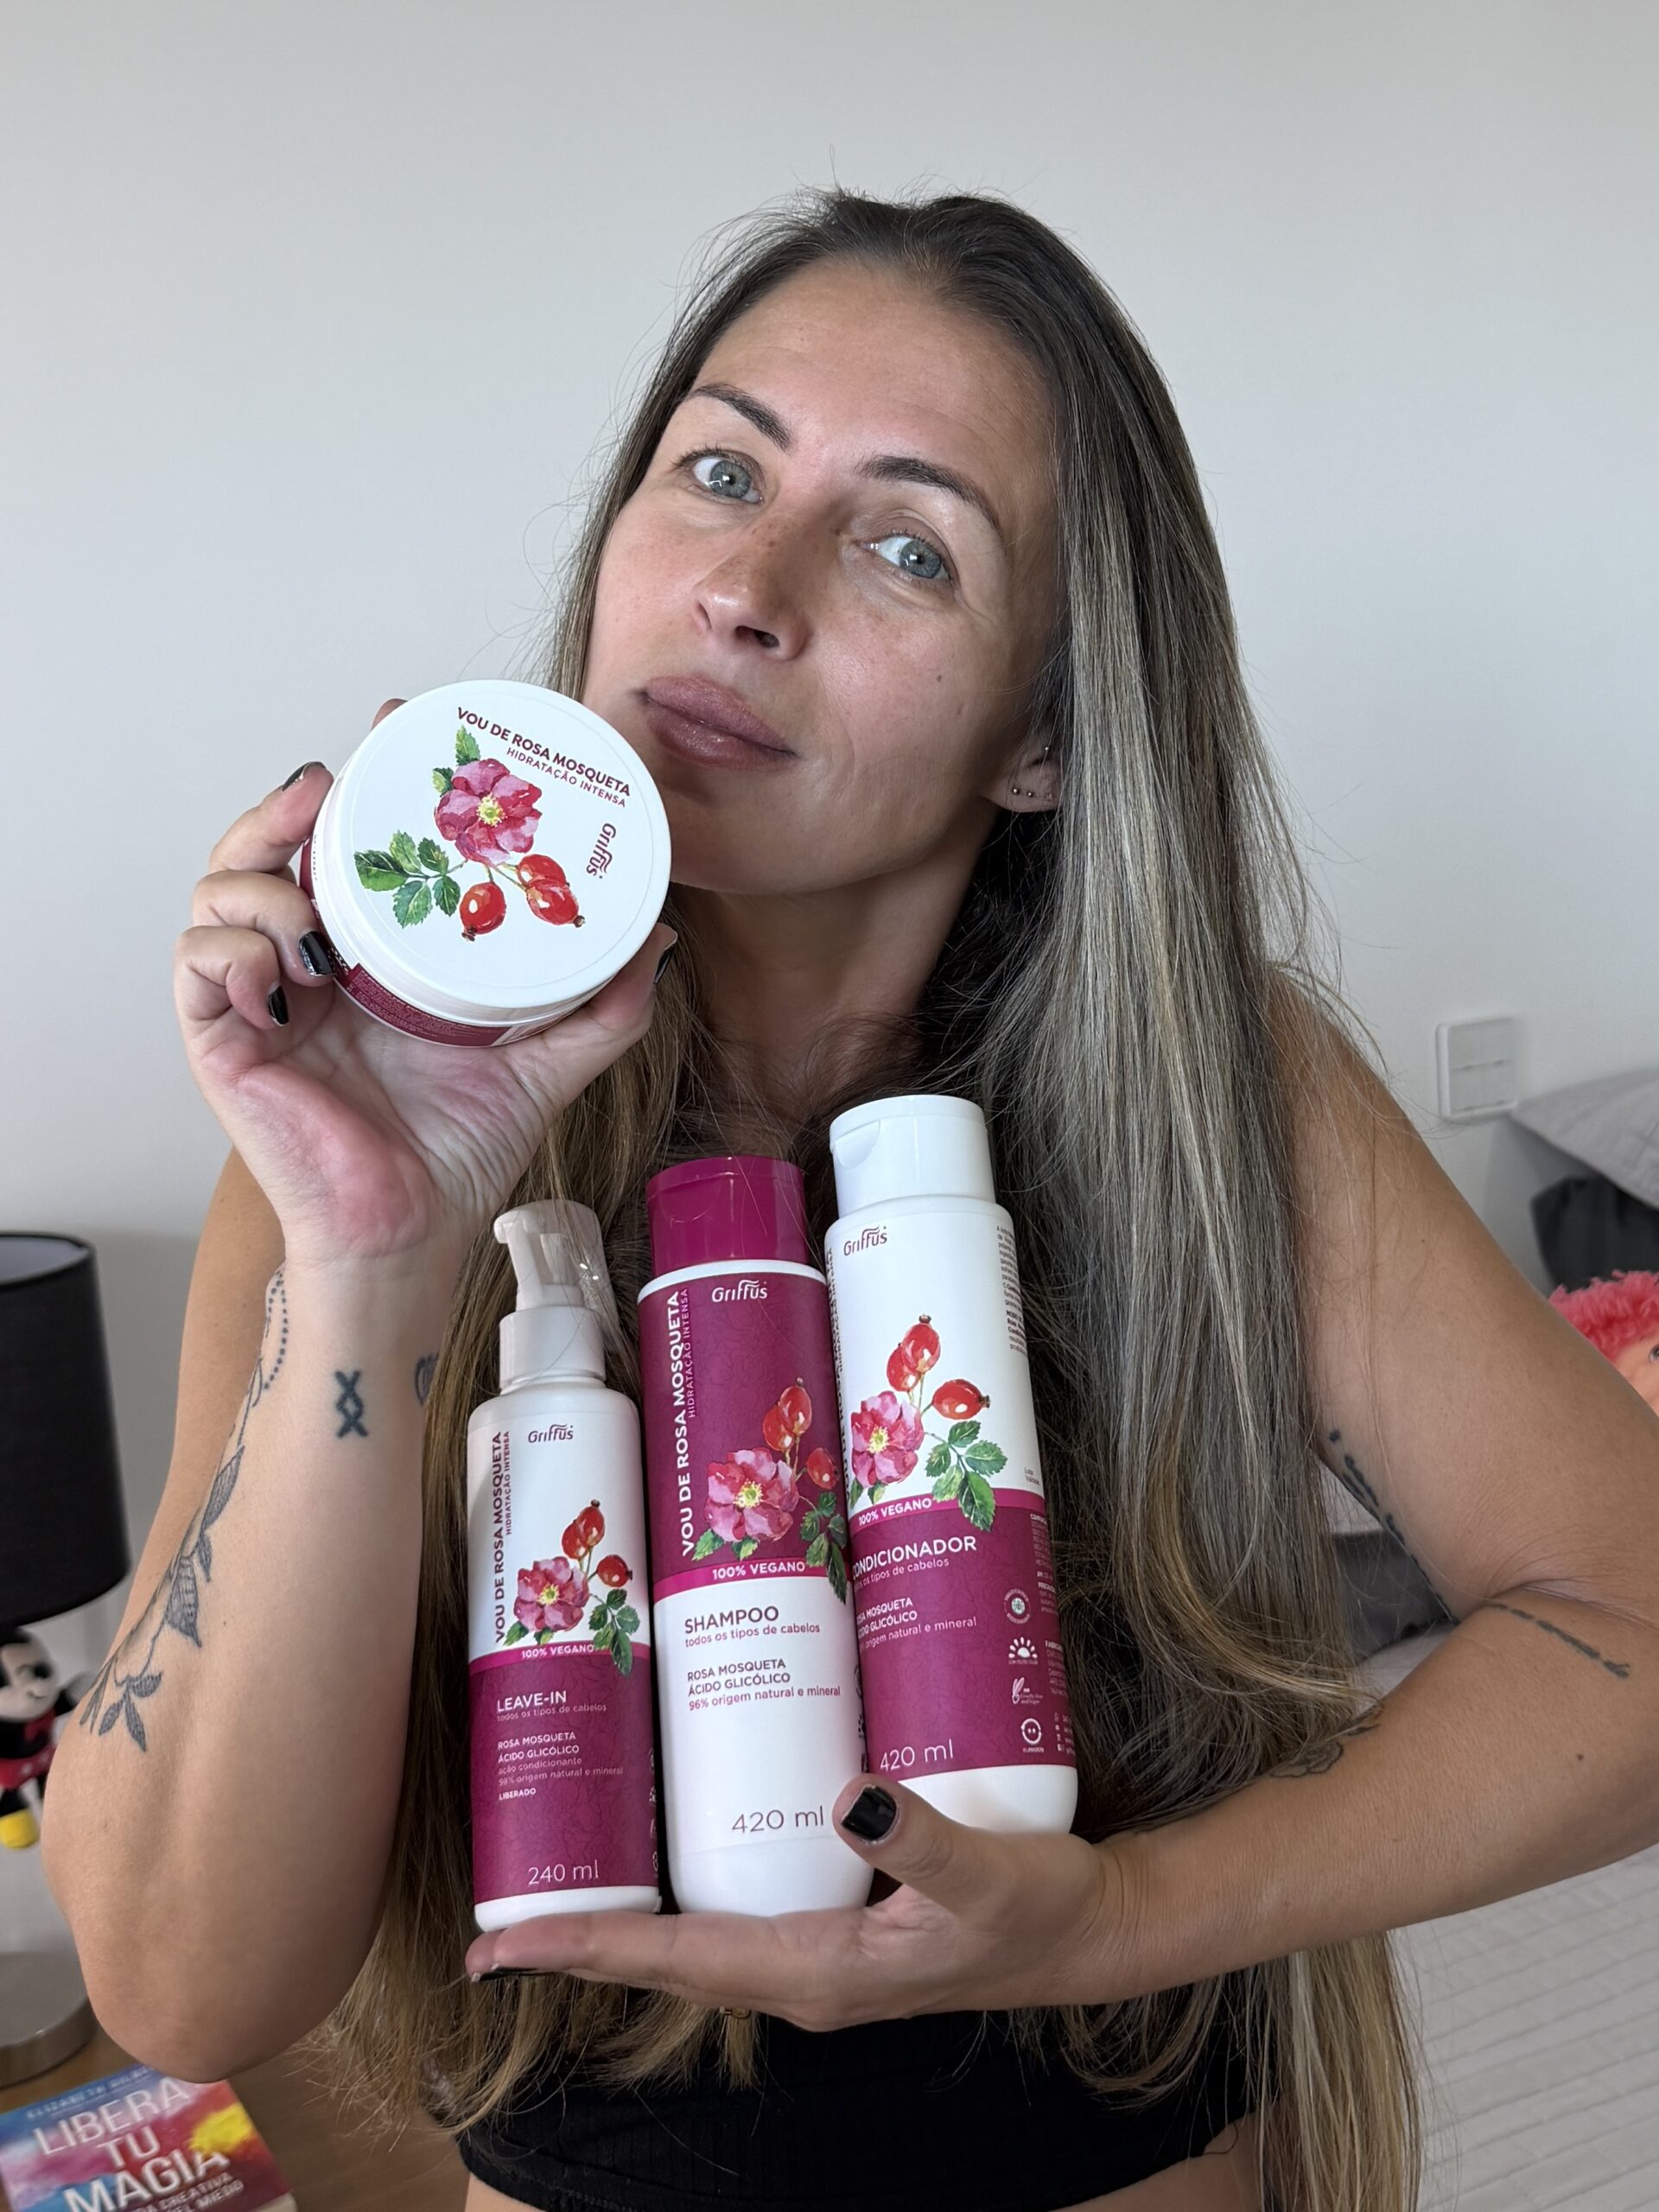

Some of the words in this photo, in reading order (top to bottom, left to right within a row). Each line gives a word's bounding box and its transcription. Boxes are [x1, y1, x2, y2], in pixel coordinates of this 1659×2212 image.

[458, 707, 489, 730] VOU
[490, 723, 512, 741] DE
[512, 734, 550, 760] ROSA
[553, 753, 631, 797] MOSQUETA
[506, 747, 576, 785] HIDRATAÇÃO
[580, 781, 626, 808] INTENSA
[586, 823, 616, 879] Griffus
[843, 1224, 887, 1256] Griffus
[712, 1280, 768, 1303] Griffus
[681, 1288, 691, 1339] INTENSA
[667, 1291, 685, 1407] MOSQUETA
[683, 1342, 696, 1419] HIDRATAÇÃO
[528, 1424, 574, 1443] Griffus
[675, 1409, 690, 1468] ROSA
[492, 1432, 503, 1524] MOSQUETA
[677, 1472, 691, 1502] DE
[504, 1474, 512, 1535] HIDRATAÇÃO
[858, 1510, 879, 1526] 100%
[880, 1497, 932, 1518] VEGANO
[681, 1508, 695, 1556] VOU
[493, 1527, 504, 1574] ROSA
[712, 1564, 747, 1580] 100%
[750, 1561, 805, 1574] VEGANO
[871, 1569, 890, 1584] tipos
[893, 1566, 905, 1577] de
[907, 1558, 950, 1573] cabelos
[494, 1577, 505, 1600] DE
[684, 1605, 779, 1634] SHAMPOO
[866, 1597, 913, 1618] MOSQUETA
[870, 1611, 918, 1631] GLICÓLICO
[495, 1605, 505, 1643] VOU
[685, 1635, 712, 1648] todos
[715, 1632, 728, 1641] os
[731, 1628, 760, 1640] tipos
[763, 1624, 777, 1635] de
[780, 1623, 820, 1634] cabelos
[888, 1624, 921, 1639] natural
[934, 1617, 977, 1630] mineral
[522, 1647, 548, 1659] 100%
[550, 1644, 594, 1656] VEGANO
[687, 1669, 715, 1682] ROSA
[718, 1658, 786, 1676] MOSQUETA
[688, 1680, 721, 1697] ÁCIDO
[725, 1673, 791, 1689] GLICÓLICO
[689, 1698, 709, 1711] 96%
[712, 1693, 751, 1707] origem
[754, 1687, 794, 1700] natural
[798, 1688, 804, 1697] e
[807, 1686, 841, 1697] mineral
[497, 1690, 567, 1713] LEAVE-IN
[497, 1712, 519, 1722] todos
[533, 1707, 556, 1719] tipos
[558, 1704, 570, 1713] de
[573, 1703, 607, 1712] cabelos
[498, 1738, 520, 1751] ROSA
[523, 1732, 576, 1745] MOSQUETA
[498, 1751, 524, 1764] ÁCIDO
[527, 1744, 580, 1758] GLICÓLICO
[880, 1746, 915, 1771] 420
[924, 1738, 954, 1763] ml
[516, 1772, 548, 1785] origem
[550, 1768, 582, 1778] natural
[593, 1766, 623, 1776] mineral
[518, 1758, 582, 1771] condicionante
[499, 1787, 537, 1802] LIBERADO
[732, 1809, 785, 1834] 420
[795, 1805, 823, 1827] ml
[528, 1864, 566, 1886] 240
[572, 1859, 599, 1880] ml
[33, 2076, 190, 2156] LIBERA
[96, 2126, 162, 2170] TU
[62, 2148, 231, 2212] MAGIA
